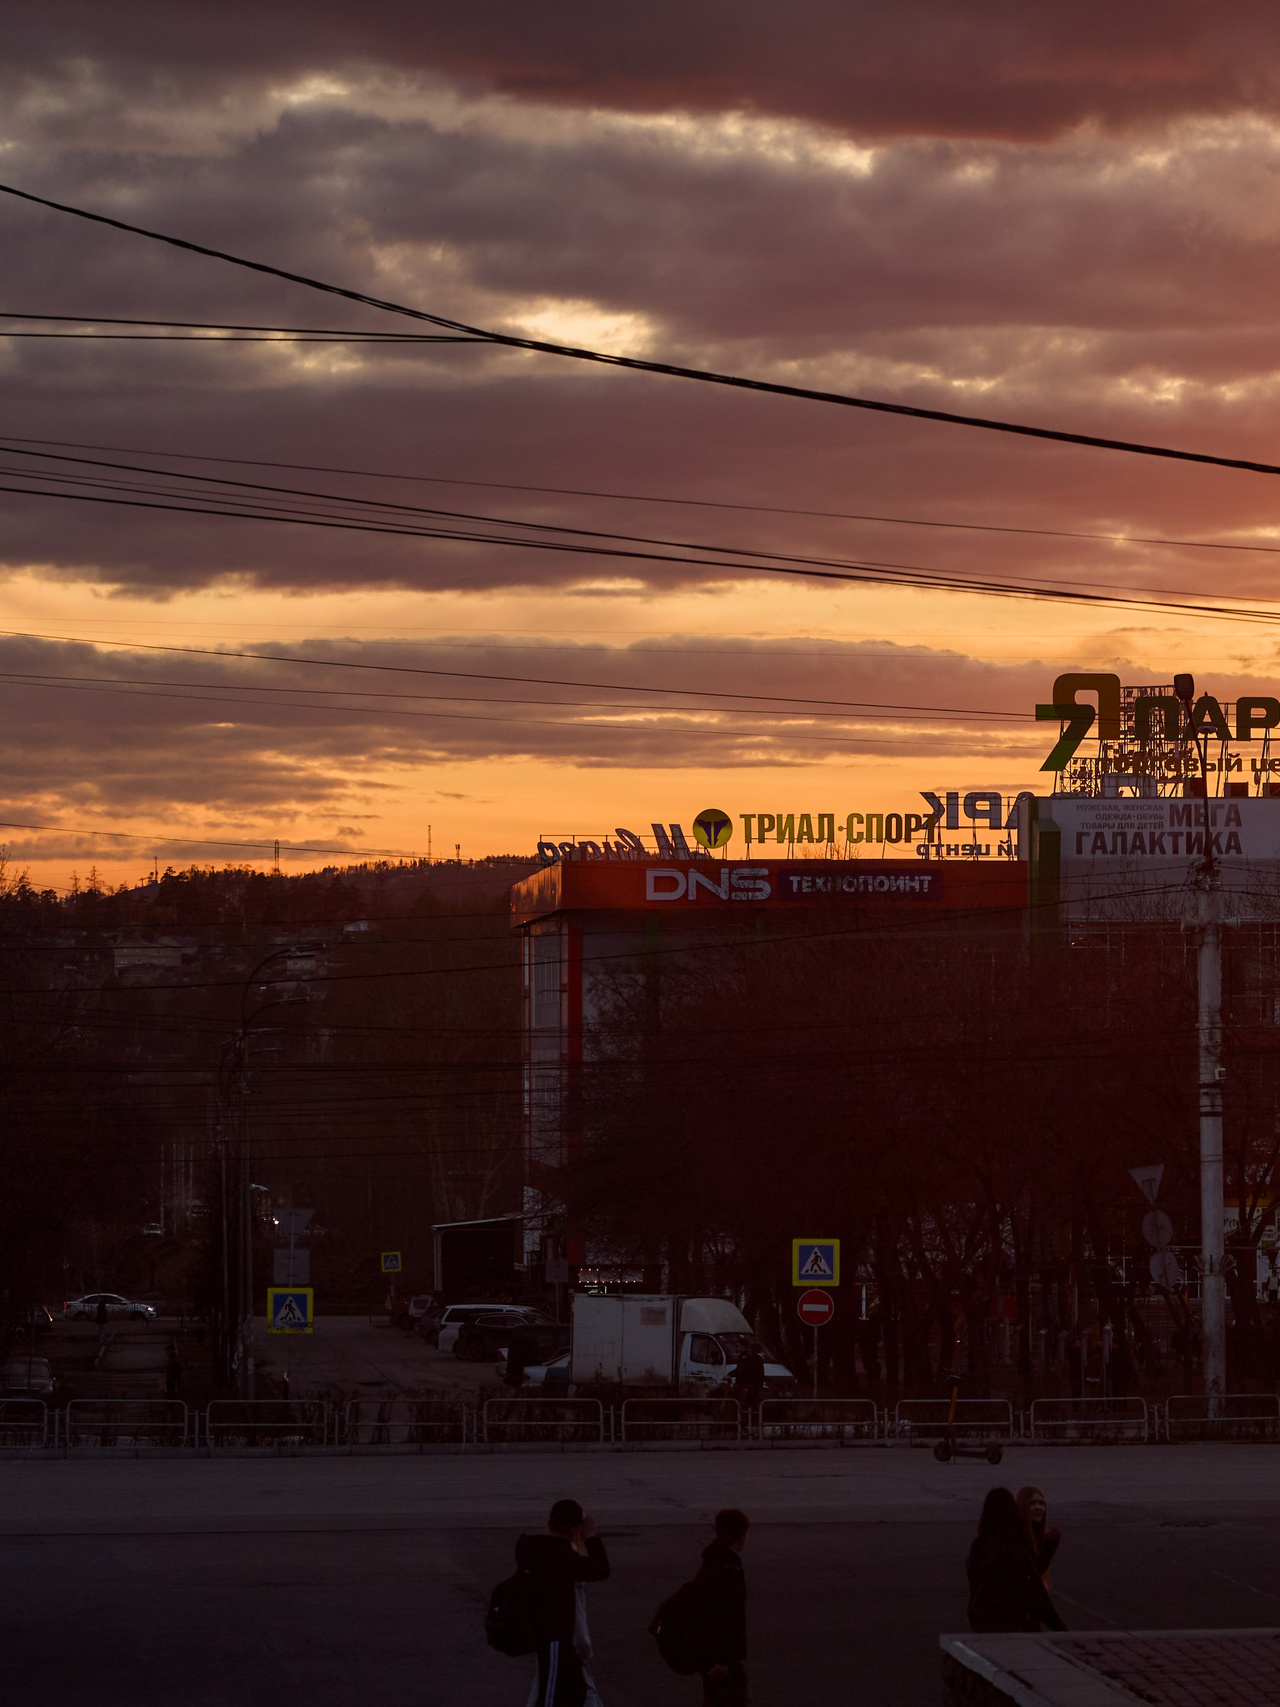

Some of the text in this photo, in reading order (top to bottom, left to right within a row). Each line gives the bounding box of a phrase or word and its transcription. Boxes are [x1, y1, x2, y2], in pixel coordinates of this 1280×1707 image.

[1076, 804, 1164, 813] МУЖСКАЯ, ЖЕНСКАЯ
[1169, 803, 1242, 828] МЕГА
[1081, 820, 1165, 831] ТОВАРЫ ДЛЯ ДЕТЕЙ
[1075, 831, 1243, 855] ГАЛАКТИКА
[646, 867, 772, 901] DNS
[788, 875, 933, 894] ТЕХНОПОИНТ
